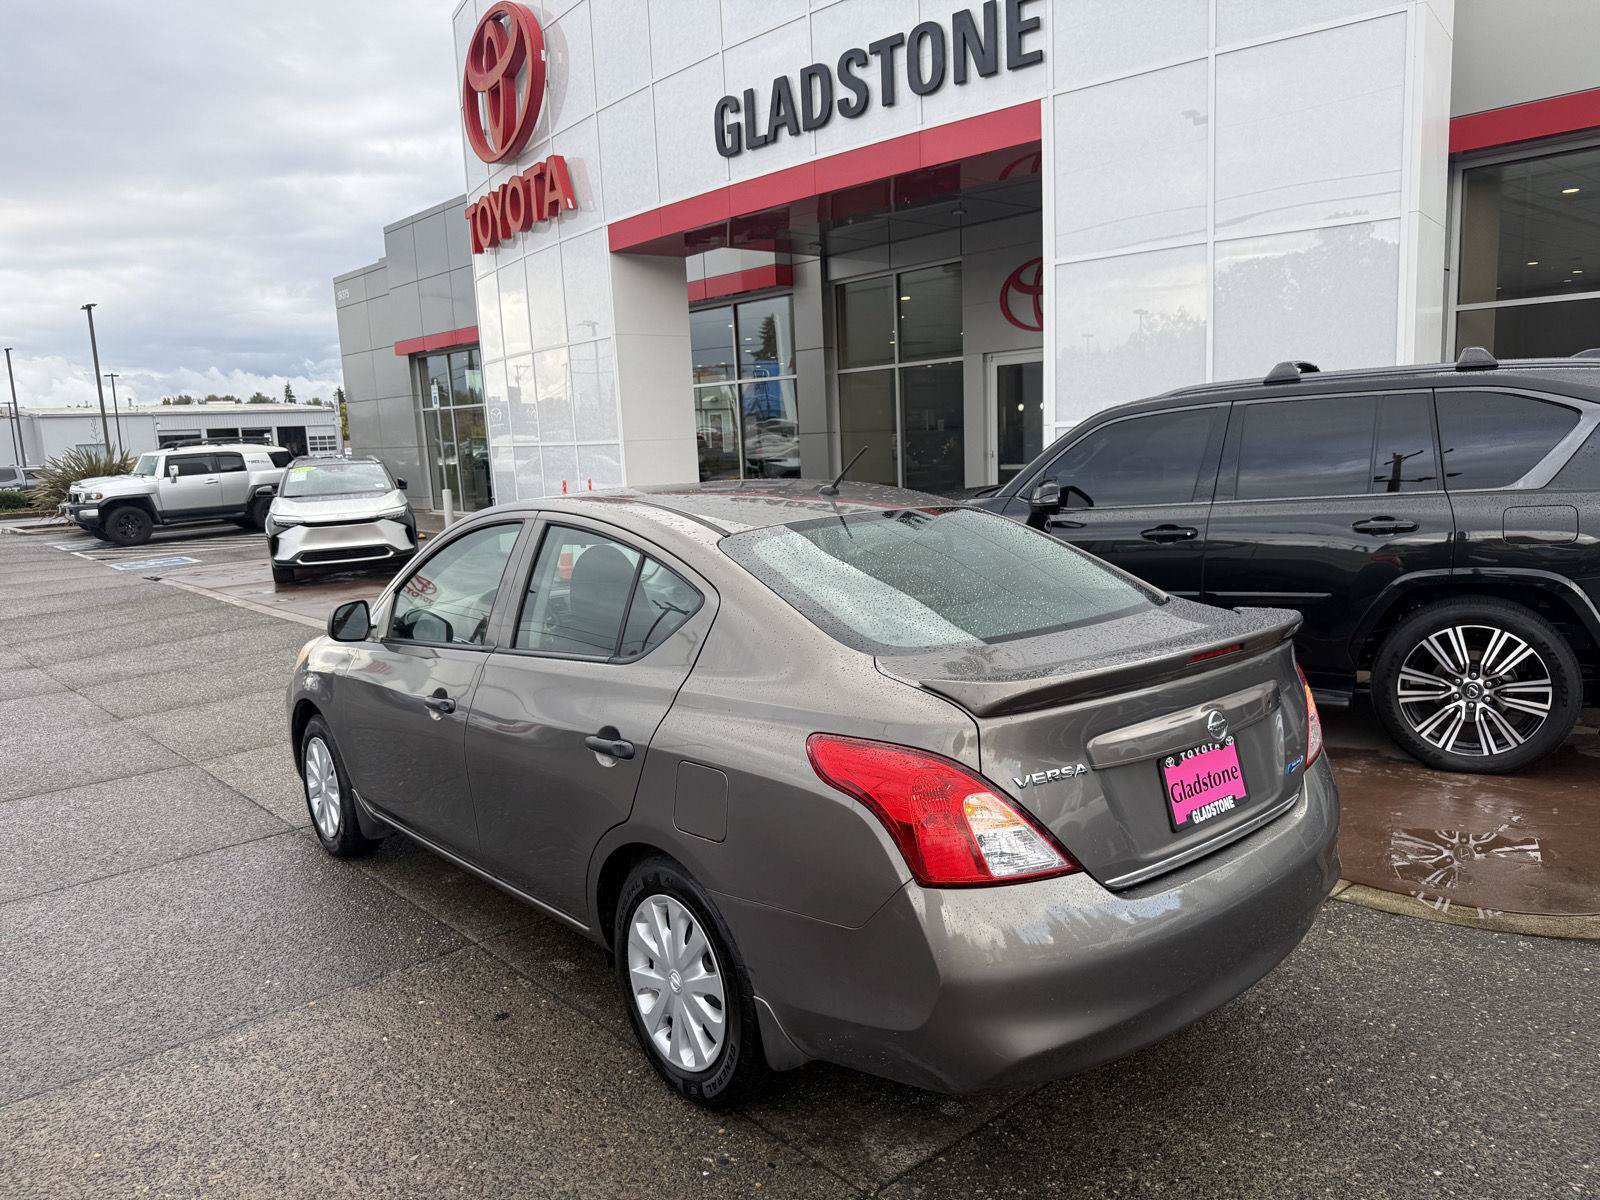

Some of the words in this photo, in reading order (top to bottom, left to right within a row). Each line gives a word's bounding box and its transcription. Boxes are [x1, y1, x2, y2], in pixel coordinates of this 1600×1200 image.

[714, 0, 1043, 157] GLADSTONE
[465, 154, 577, 255] TOYOTA
[1180, 742, 1220, 761] TOYOTA
[1012, 763, 1087, 789] VERSA
[1170, 765, 1239, 803] Gladstone
[1192, 795, 1235, 824] GLADSTONE
[705, 1042, 736, 1093] GENERAL
